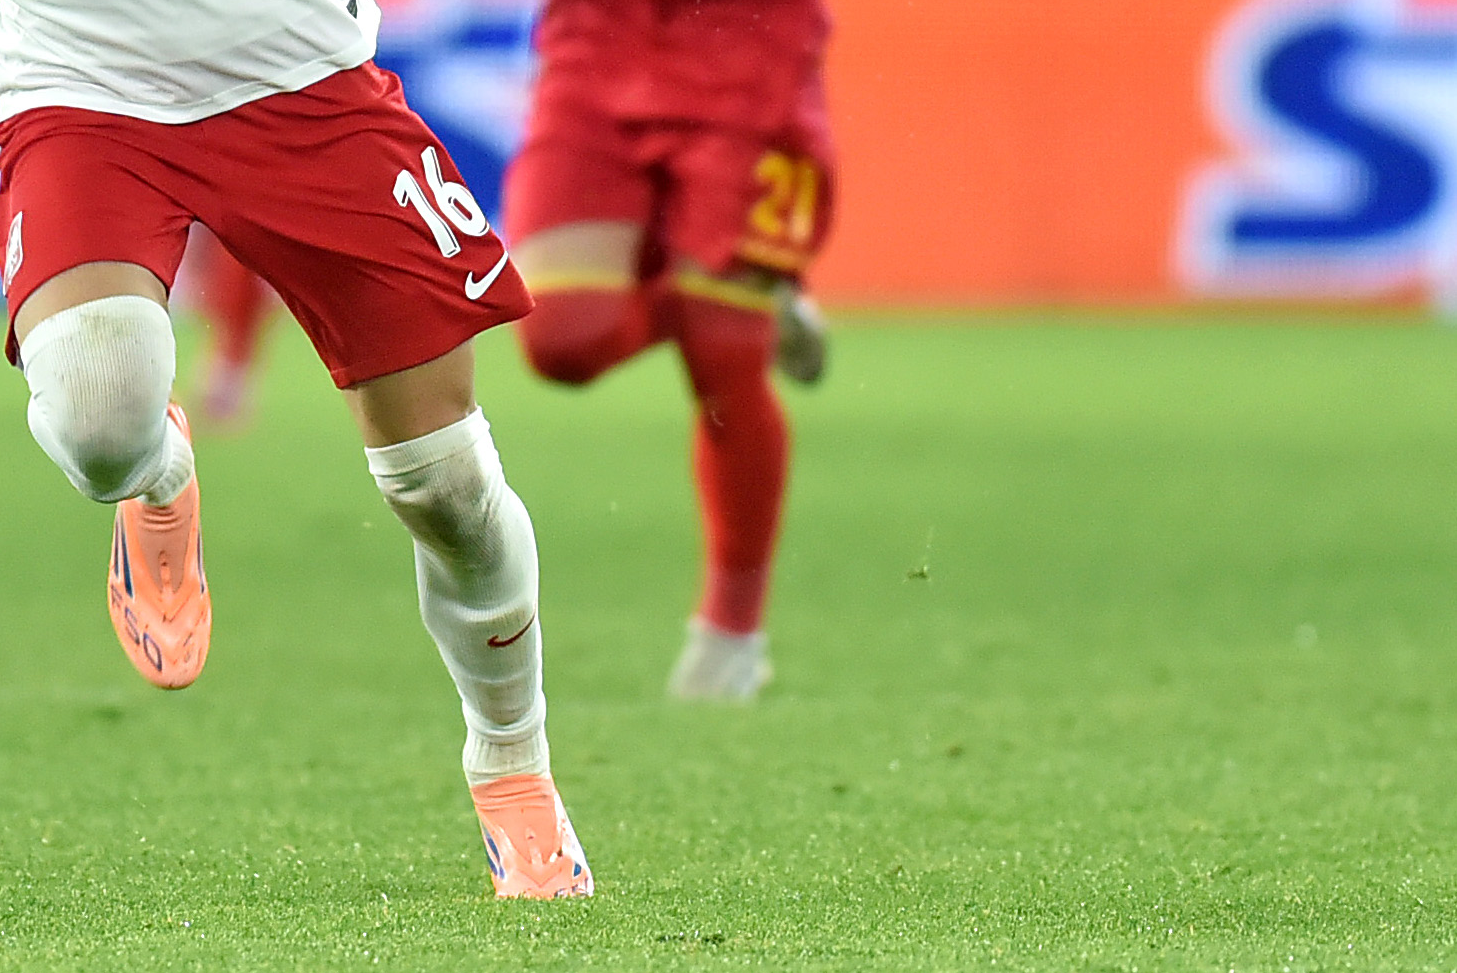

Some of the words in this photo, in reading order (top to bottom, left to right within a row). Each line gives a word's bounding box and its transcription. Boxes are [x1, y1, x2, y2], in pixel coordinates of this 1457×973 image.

[393, 146, 490, 258] 16
[750, 152, 814, 242] 21
[110, 584, 162, 672] F50
